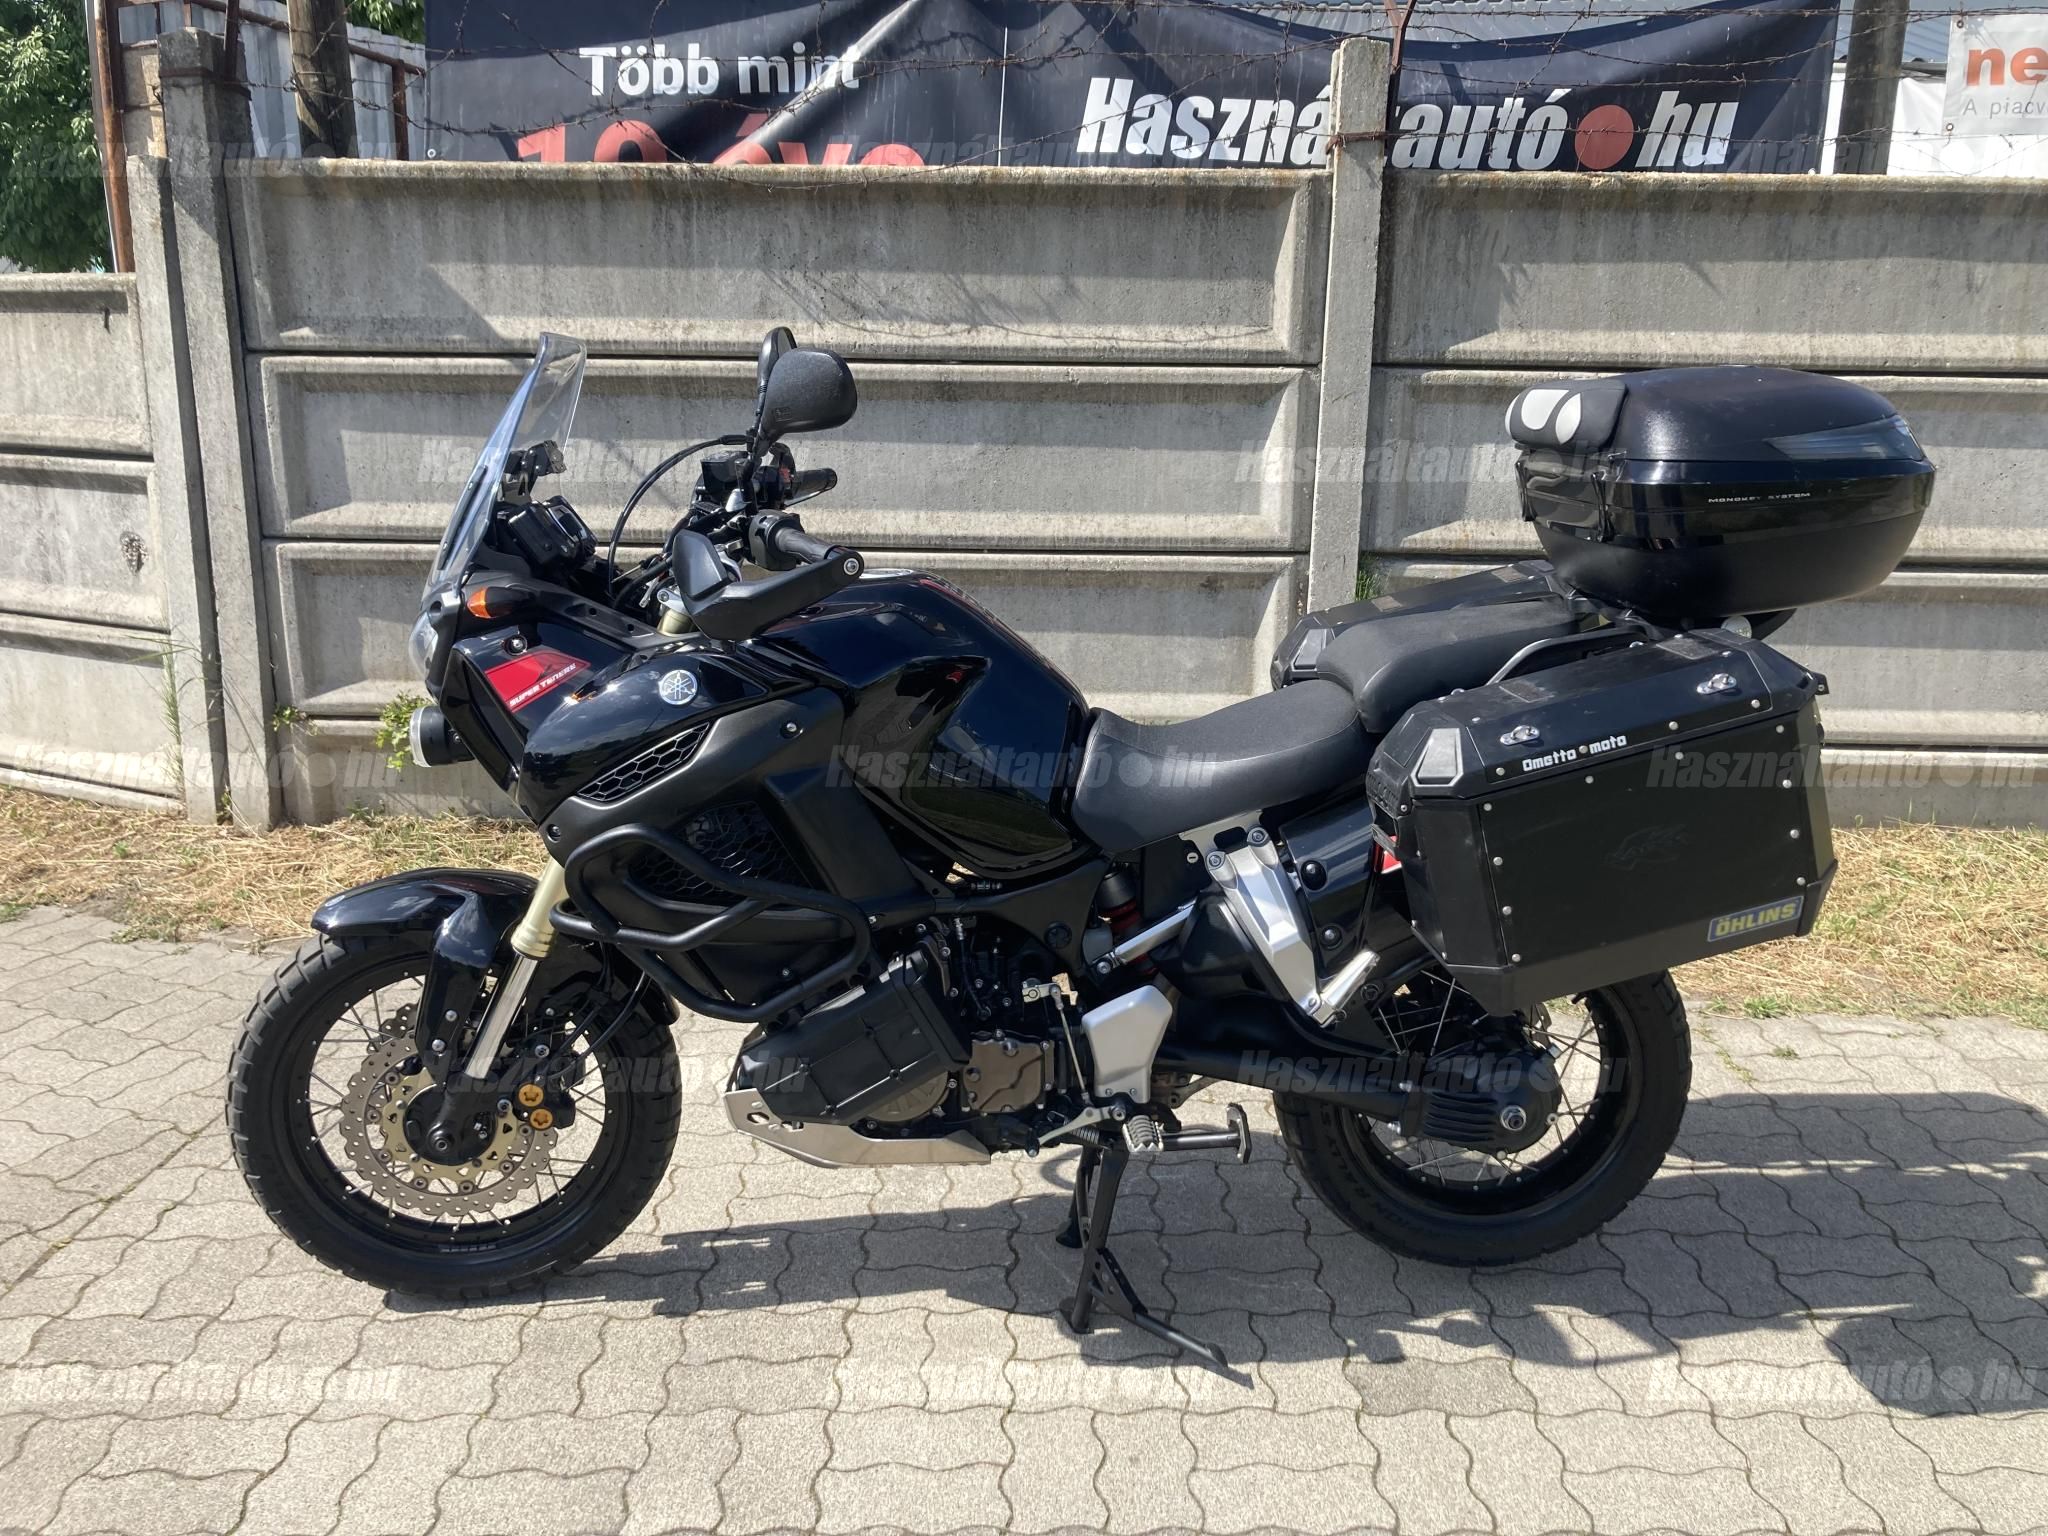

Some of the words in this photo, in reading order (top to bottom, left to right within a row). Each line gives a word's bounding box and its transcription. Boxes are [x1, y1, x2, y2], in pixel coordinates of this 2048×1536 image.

[579, 42, 719, 96] Több
[738, 41, 859, 95] mint
[1962, 99, 1977, 116] A
[1990, 97, 2048, 119] piacv
[509, 684, 540, 707] SUPER
[1715, 902, 1797, 937] ÖHLINS
